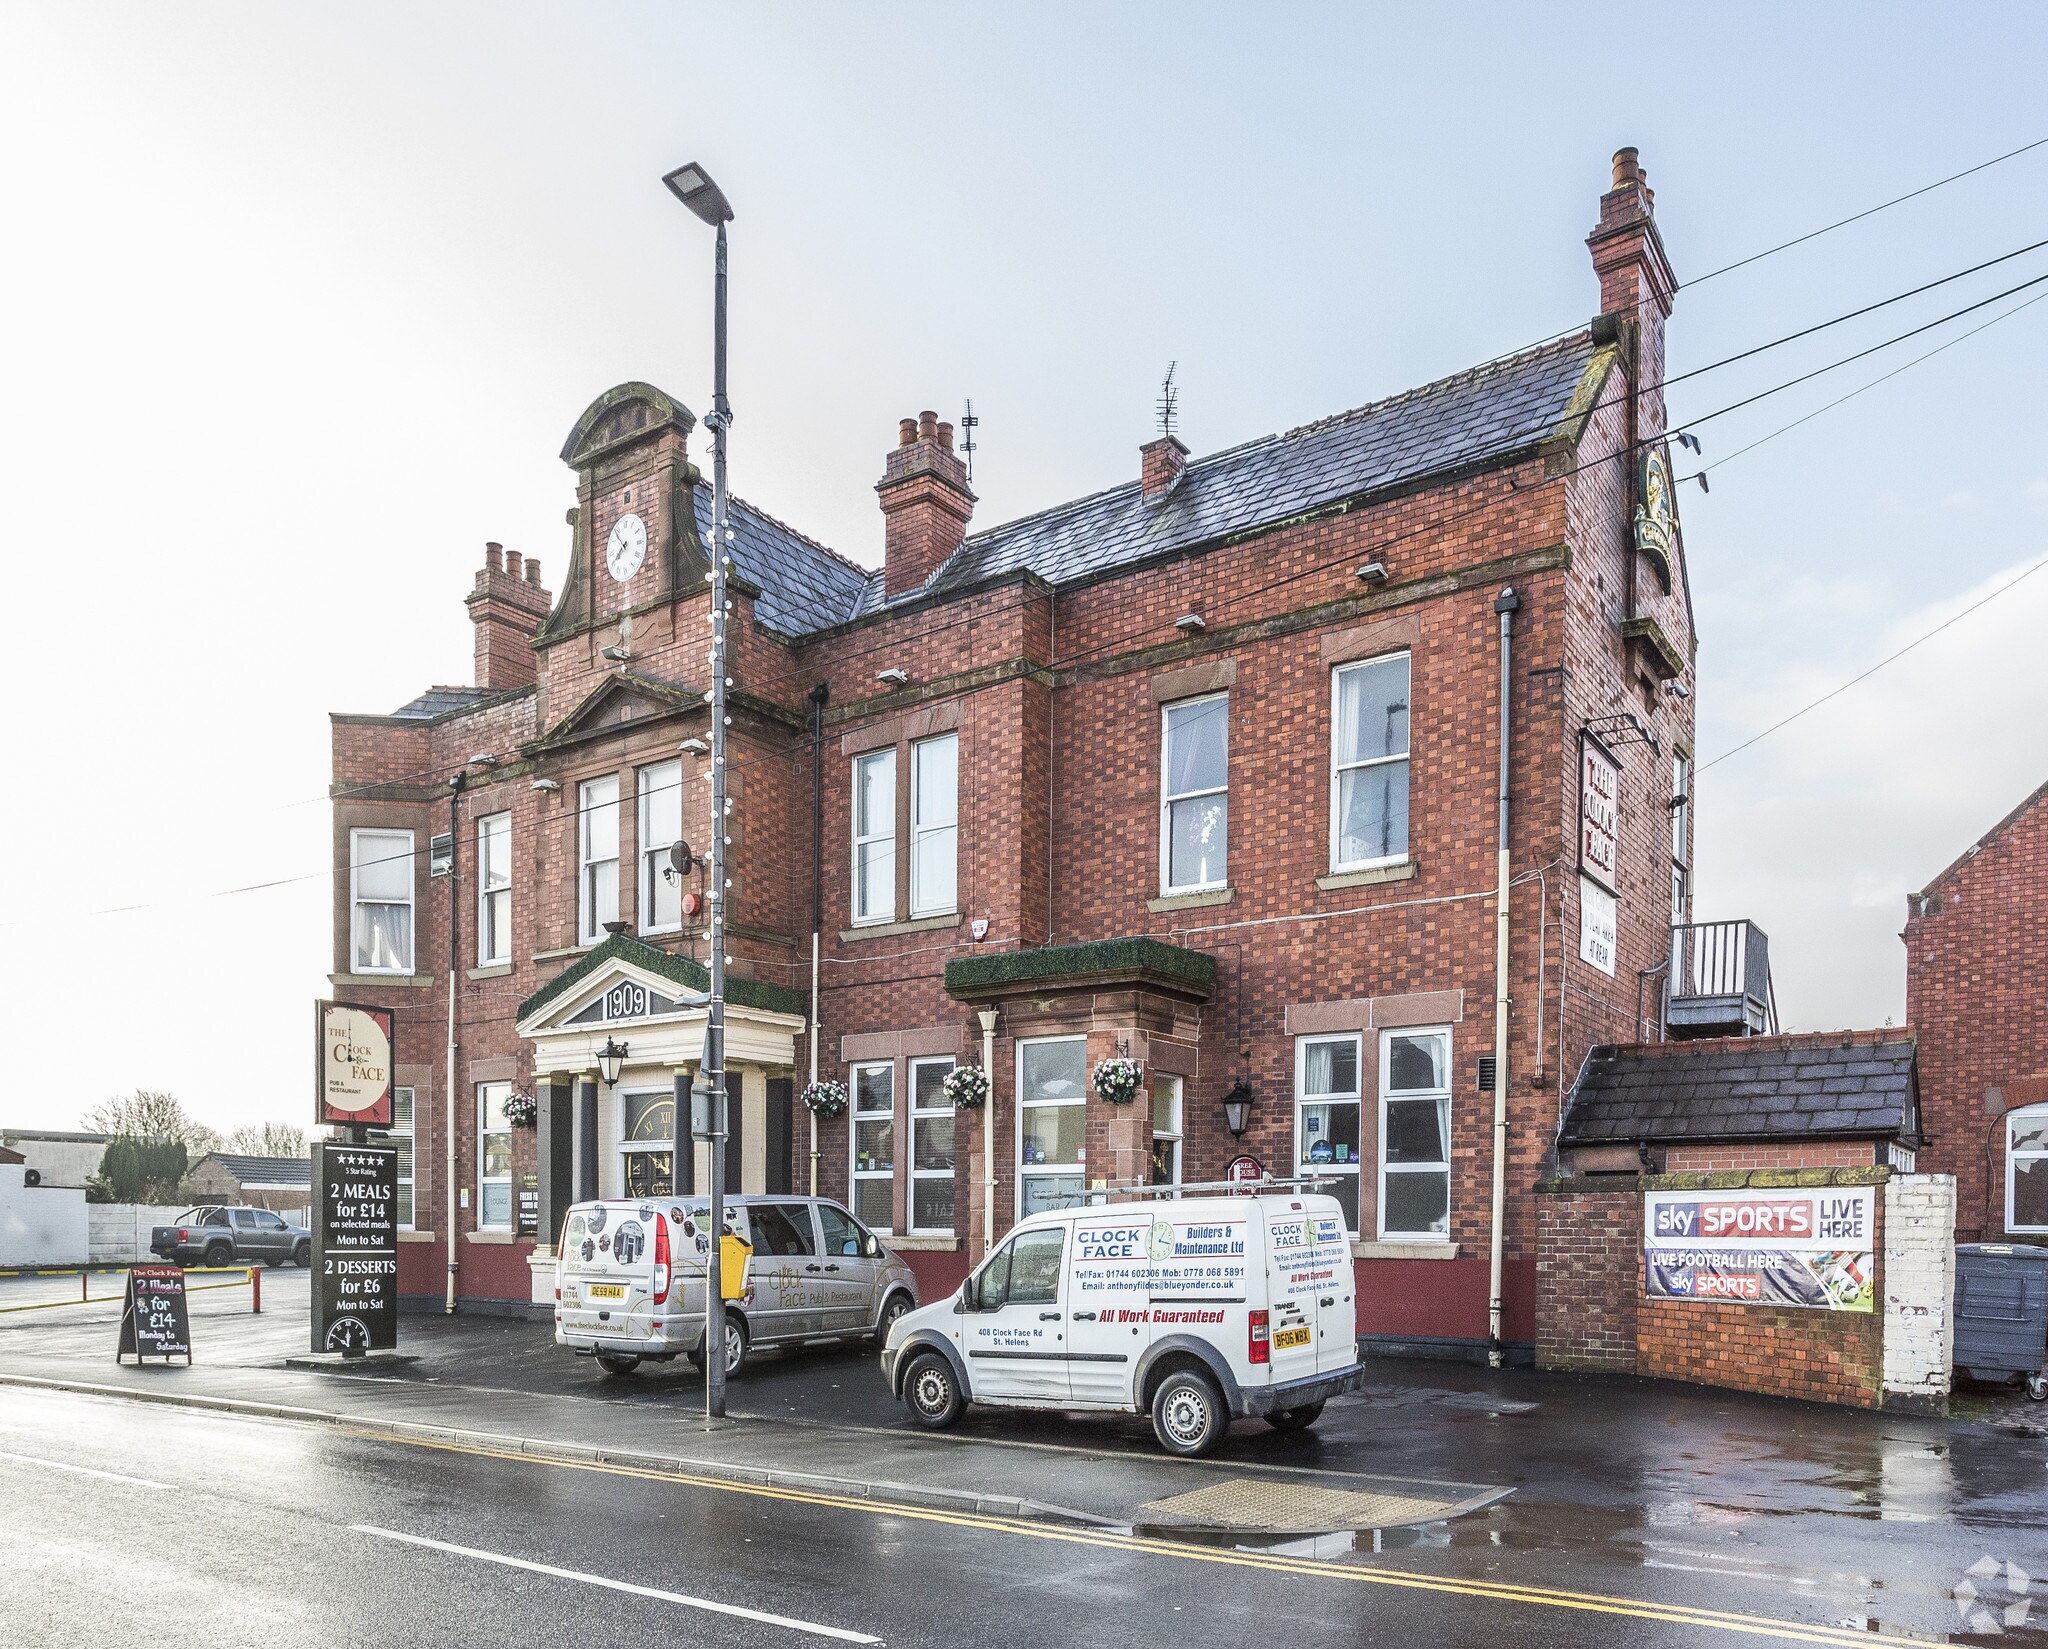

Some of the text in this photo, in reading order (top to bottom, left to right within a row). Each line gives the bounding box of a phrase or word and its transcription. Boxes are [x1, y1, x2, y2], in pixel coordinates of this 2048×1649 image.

[1588, 757, 1612, 800] THE
[1584, 792, 1619, 841] CLOCK
[1585, 830, 1612, 872] FACE
[1589, 939, 1608, 966] AT REAR
[608, 984, 644, 1017] 1909
[328, 1027, 347, 1038] THE
[352, 1065, 385, 1081] FACE
[329, 1087, 361, 1095] RESTAURANT
[345, 1167, 377, 1177] 5 Star Rating
[330, 1183, 391, 1200] 2 MEALS
[336, 1200, 385, 1218] for £14
[1046, 1202, 1060, 1211] BAR
[1820, 1198, 1864, 1220] LIVE
[341, 1219, 370, 1229] selected
[371, 1219, 391, 1229] meals
[1658, 1205, 1809, 1236] sky SPORTS
[1187, 1226, 1232, 1239] Builders &
[1271, 1224, 1302, 1236] CLOCK
[1819, 1220, 1863, 1238] HERE
[336, 1234, 384, 1245] Mon to Sat
[1078, 1229, 1140, 1244] CLOCK
[1276, 1235, 1301, 1246] FACE
[1083, 1244, 1132, 1258] FACE
[1175, 1241, 1244, 1255] Maintenance Ltd
[324, 1259, 396, 1275] 2 DESSERTS
[1651, 1253, 1782, 1269] LIVE FOOTBALL HERE
[768, 1268, 804, 1290] Clock
[1106, 1269, 1129, 1279] 01744
[1131, 1268, 1160, 1278] 602306
[1162, 1268, 1181, 1278] Mob:
[1183, 1268, 1204, 1278] 0778
[1206, 1268, 1222, 1277] 068
[1224, 1267, 1244, 1277] 5891
[136, 1279, 182, 1294] 2 Meals
[340, 1277, 380, 1294] for £6
[1082, 1281, 1105, 1290] Email:
[1671, 1274, 1757, 1293] sky SPORTS
[592, 1286, 620, 1296] DE59 HAA
[150, 1295, 171, 1311] for
[336, 1299, 384, 1310] Mon to Sat
[780, 1289, 806, 1308] Face
[809, 1292, 823, 1304] Pub
[831, 1290, 863, 1303] Restaurant
[1273, 1301, 1296, 1311] TRANSIT
[149, 1312, 177, 1328] £14
[1099, 1309, 1225, 1323] All Work Guaranteed
[565, 1321, 624, 1332] www.theclockface.co.uk
[978, 1328, 1043, 1337] 408 Clock Face Rd
[138, 1329, 175, 1341] Monday to
[993, 1337, 1029, 1346] St. Helens
[1275, 1332, 1294, 1347] BF06
[156, 1341, 188, 1352] Saturday
